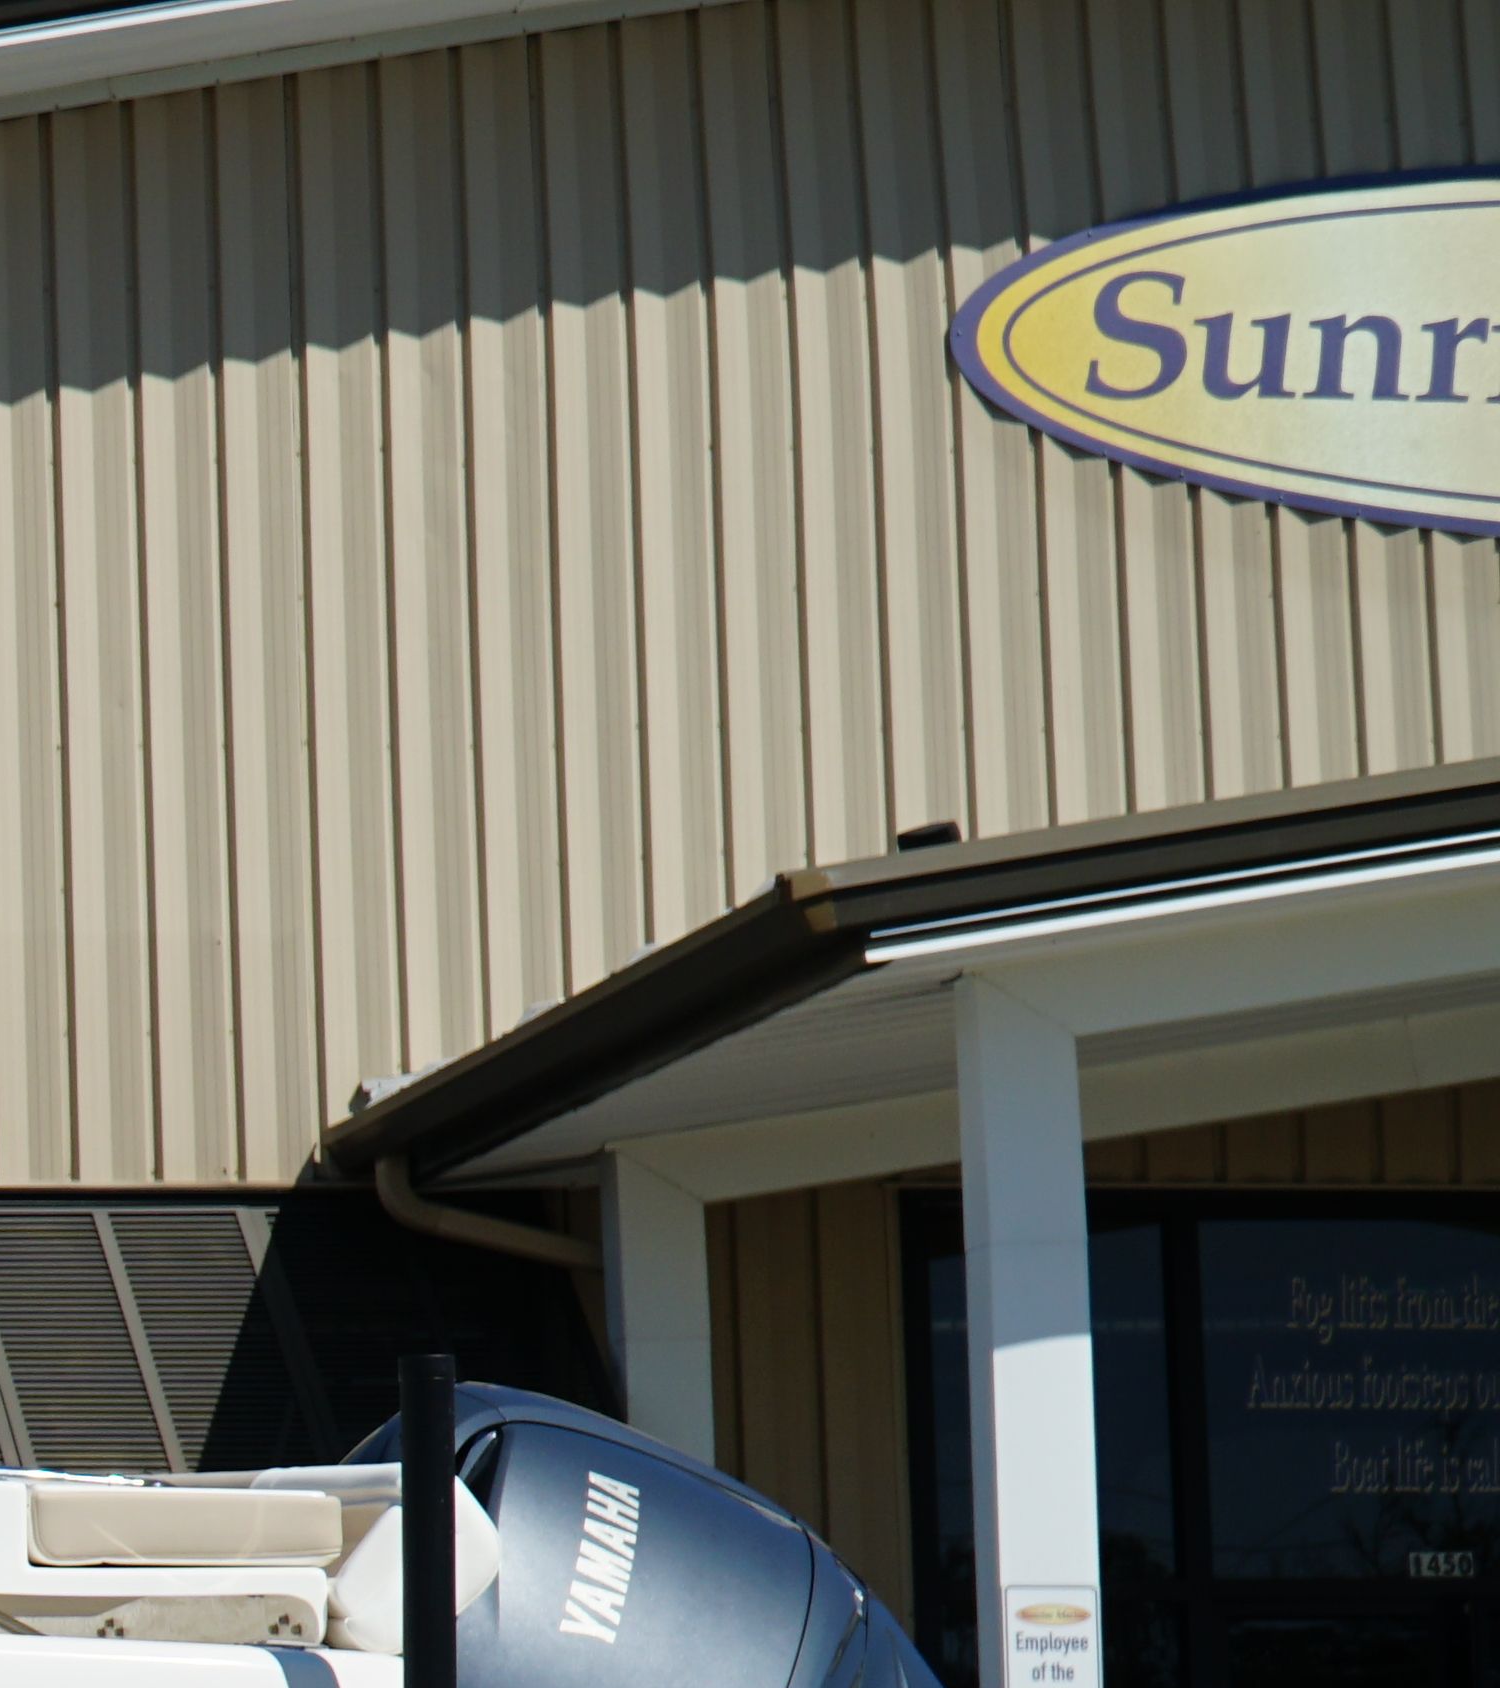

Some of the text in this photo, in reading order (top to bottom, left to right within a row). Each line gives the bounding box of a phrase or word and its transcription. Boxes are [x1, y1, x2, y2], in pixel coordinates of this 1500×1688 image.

[1084, 269, 1500, 402] Sunr
[1393, 1275, 1456, 1329] from
[1330, 1440, 1390, 1493] Boat
[559, 1470, 640, 1645] YAMAHA
[1410, 1554, 1473, 1576] 1450
[1015, 1631, 1089, 1656] Employee
[1032, 1662, 1074, 1682] of the
